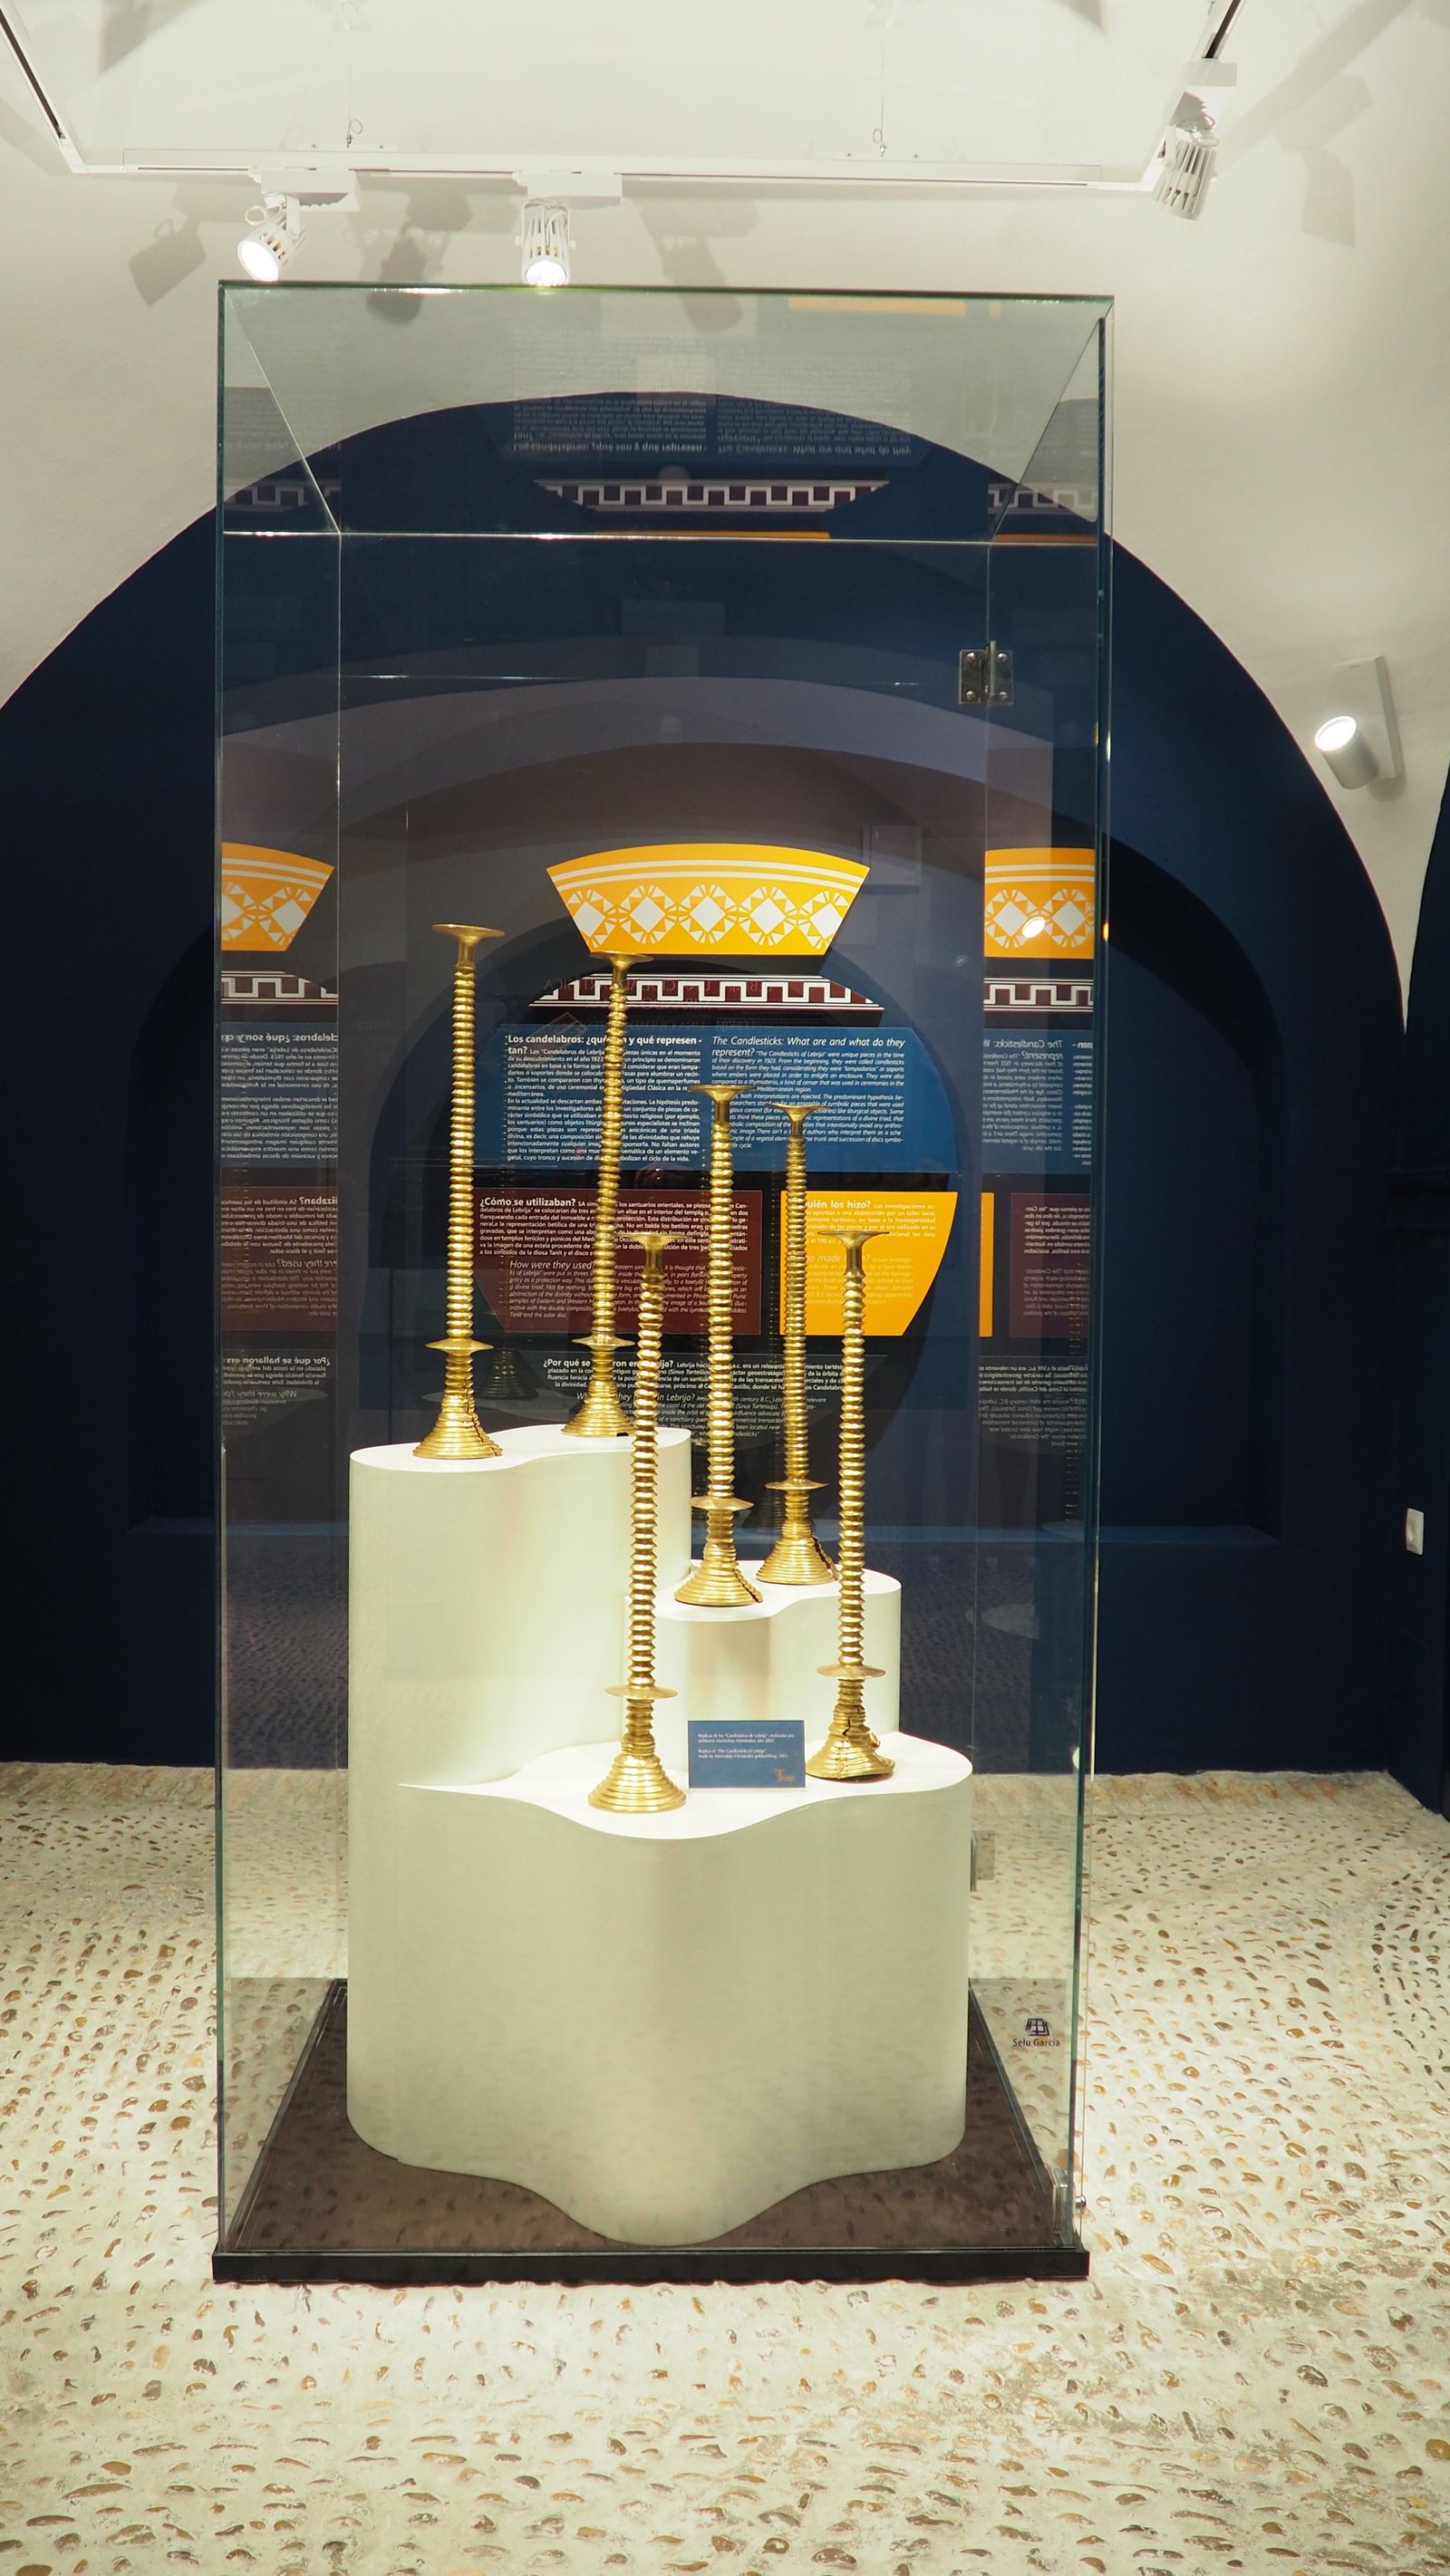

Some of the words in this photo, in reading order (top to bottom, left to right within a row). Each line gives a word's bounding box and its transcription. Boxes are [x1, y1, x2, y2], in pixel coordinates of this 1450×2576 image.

[629, 1037, 635, 1046] y
[637, 1036, 655, 1046] qué
[713, 1036, 727, 1044] The
[731, 1036, 784, 1045] Candlesticks:
[787, 1037, 810, 1045] What
[829, 1037, 847, 1046] and
[849, 1037, 870, 1046] what
[873, 1038, 884, 1046] do
[886, 1038, 905, 1048] they
[712, 1048, 755, 1057] represent?
[480, 1198, 511, 1207] ¿Cómo
[510, 1260, 529, 1268] How
[553, 1261, 571, 1271] they
[543, 1359, 562, 1368] ¿Por
[563, 1359, 579, 1368] qué
[666, 1393, 695, 1403] Lebrija?
[1013, 2038, 1031, 2047] Selu
